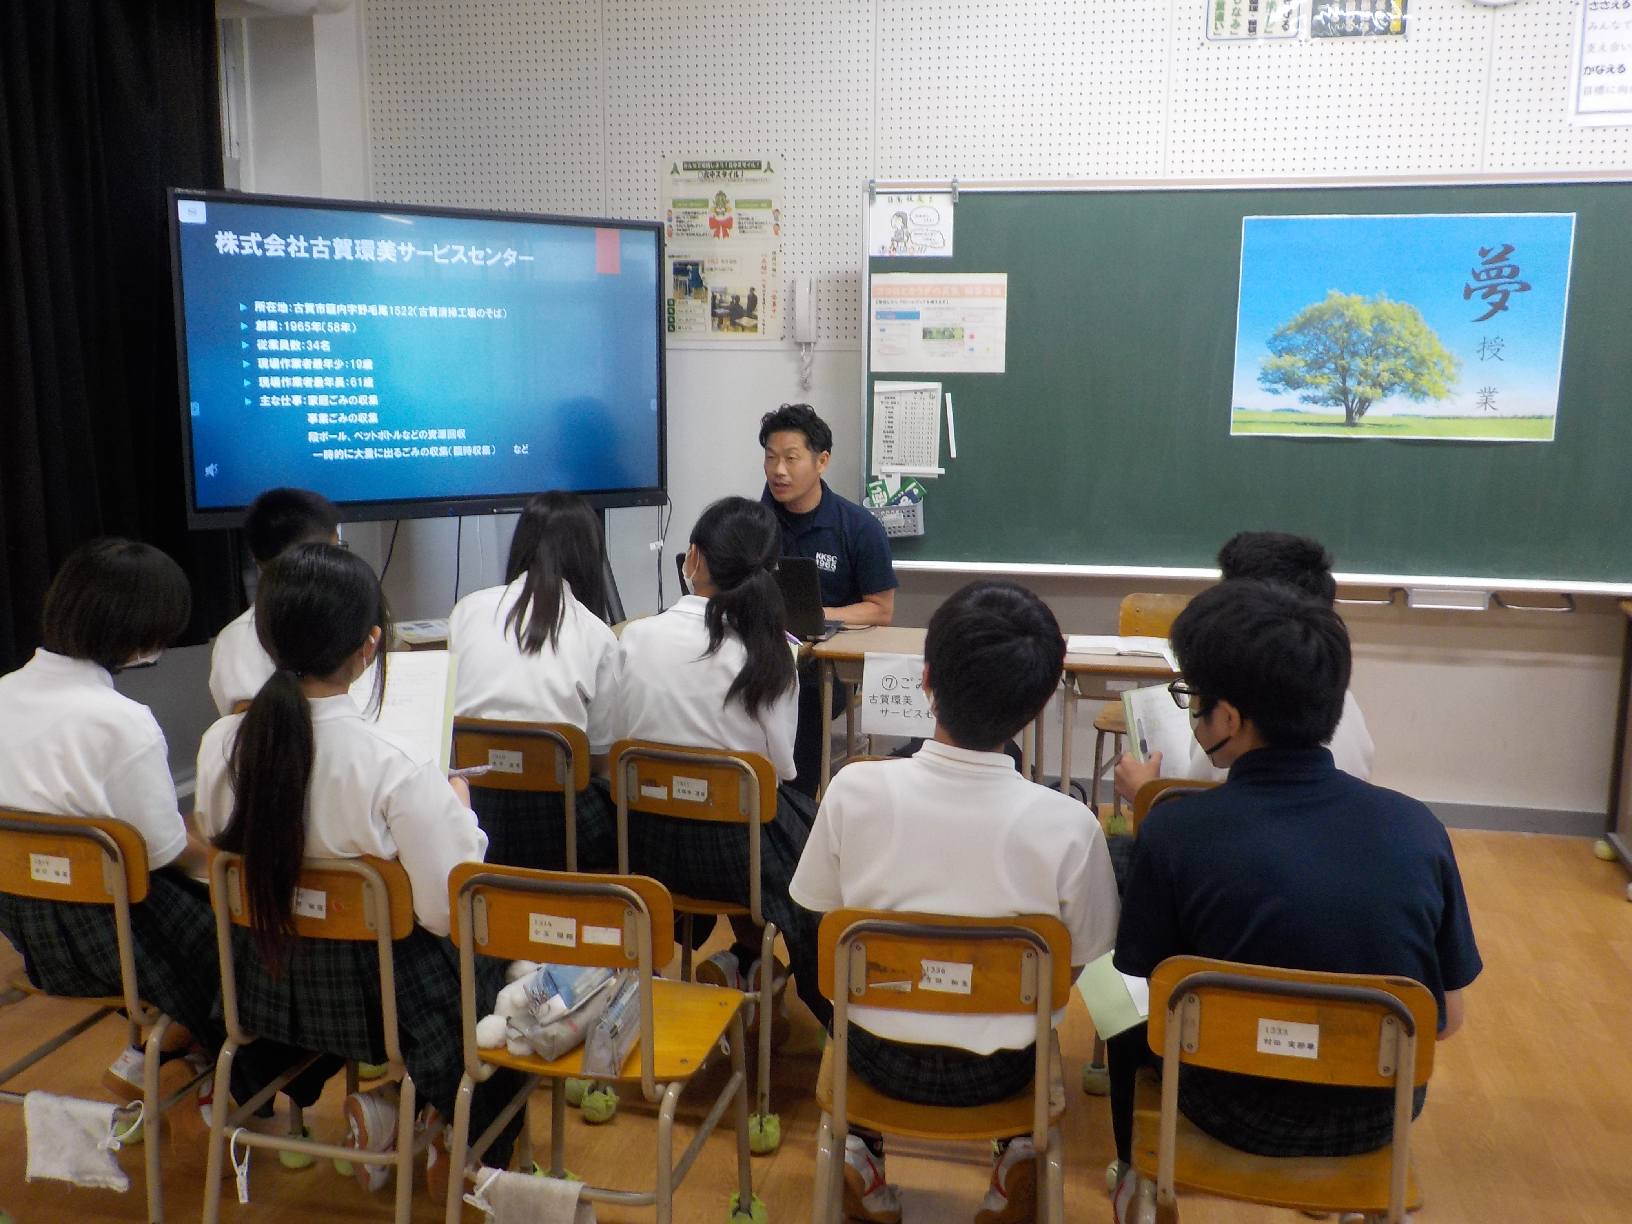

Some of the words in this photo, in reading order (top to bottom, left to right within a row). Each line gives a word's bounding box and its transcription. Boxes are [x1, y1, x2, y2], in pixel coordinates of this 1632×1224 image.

[1588, 0, 1631, 11] ささえる
[1583, 64, 1626, 76] かなえる
[1583, 85, 1632, 96] 目標に向
[214, 230, 535, 267] 株式会社古賀環美サービスセンター
[1463, 243, 1532, 323] 夢
[877, 286, 960, 296] ココロとカラダの天気
[256, 338, 331, 352] 従業員数：34名
[257, 357, 373, 370] 現場作業者最年少：19歳
[1475, 336, 1505, 411] 授業
[258, 376, 374, 389] 現場作業者最年長：61歳
[306, 412, 379, 424] 事業ごみの収集
[513, 443, 529, 455] など
[816, 551, 838, 563] KKSC
[816, 559, 837, 570] 1965
[868, 694, 913, 706] 古賀環美
[926, 965, 946, 974] 1336
